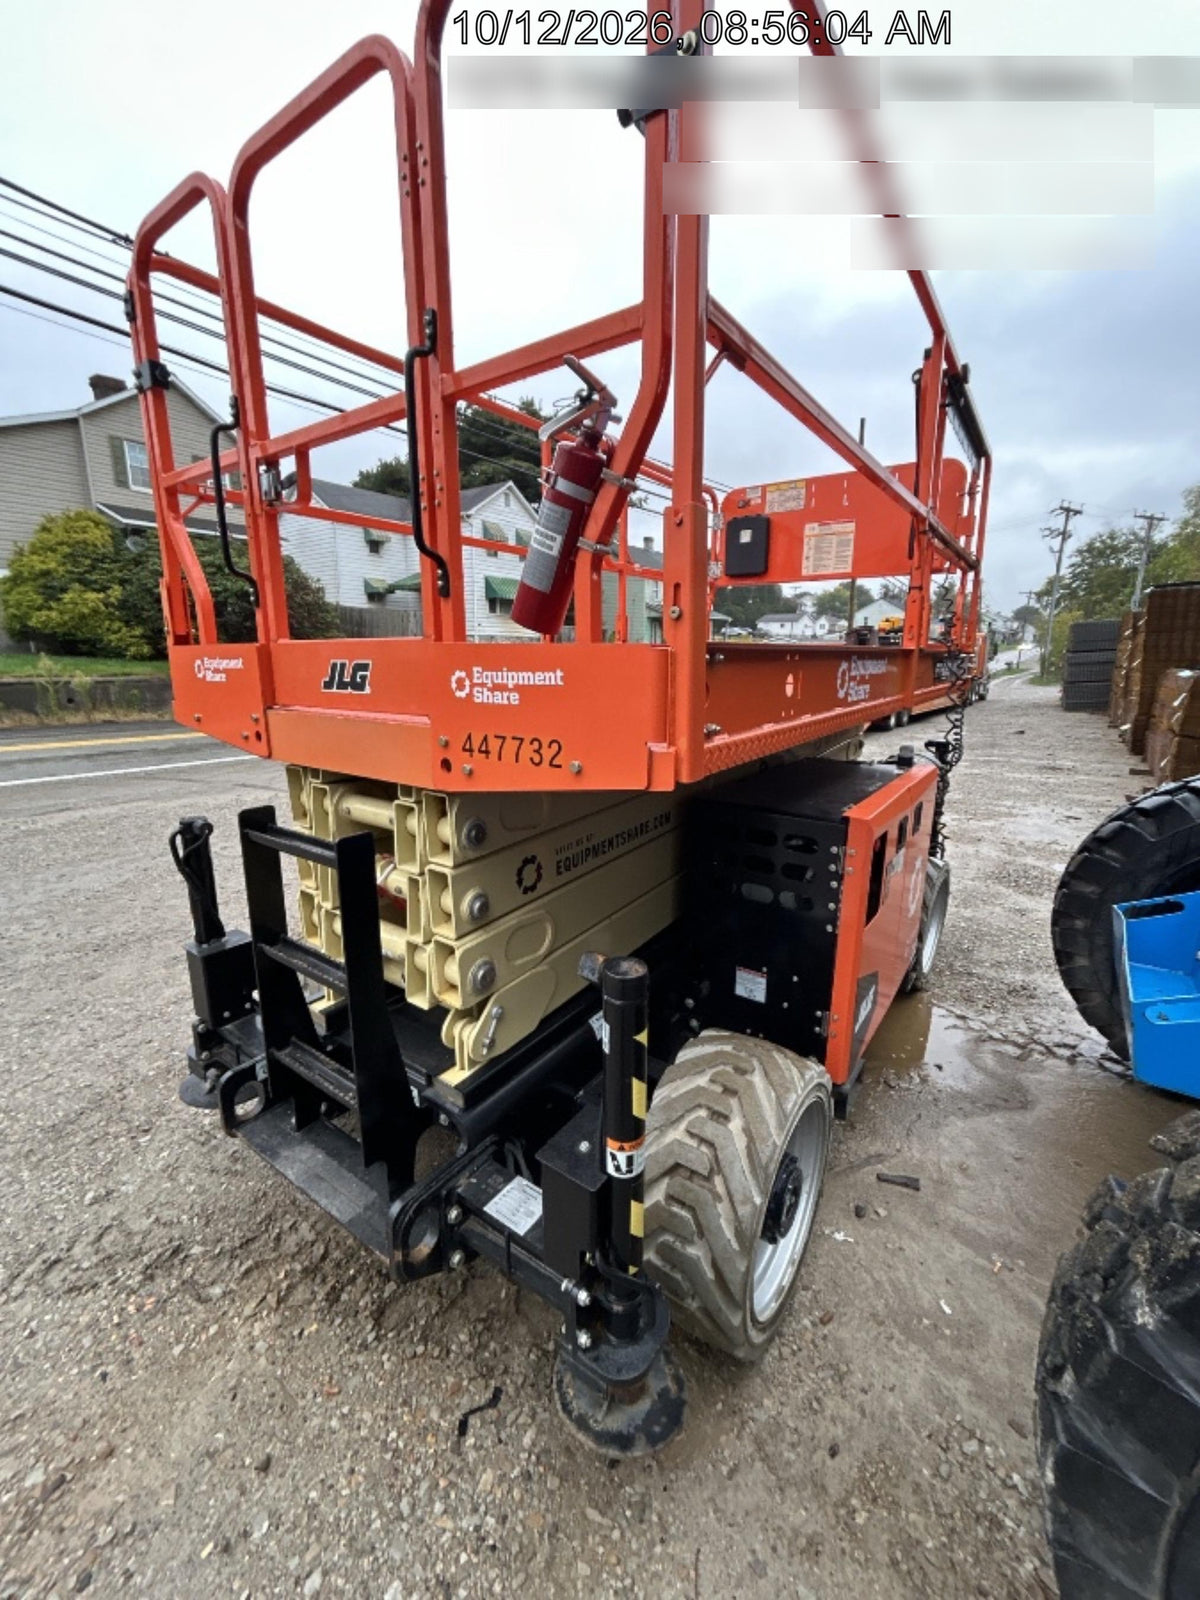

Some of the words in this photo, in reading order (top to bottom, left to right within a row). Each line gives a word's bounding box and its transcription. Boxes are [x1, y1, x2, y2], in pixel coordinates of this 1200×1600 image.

[321, 659, 372, 694] JLG
[472, 666, 564, 688] Equipment
[473, 687, 520, 705] Share
[461, 732, 563, 769] 447732
[555, 811, 672, 876] EQUIPMENTSHARE.COM
